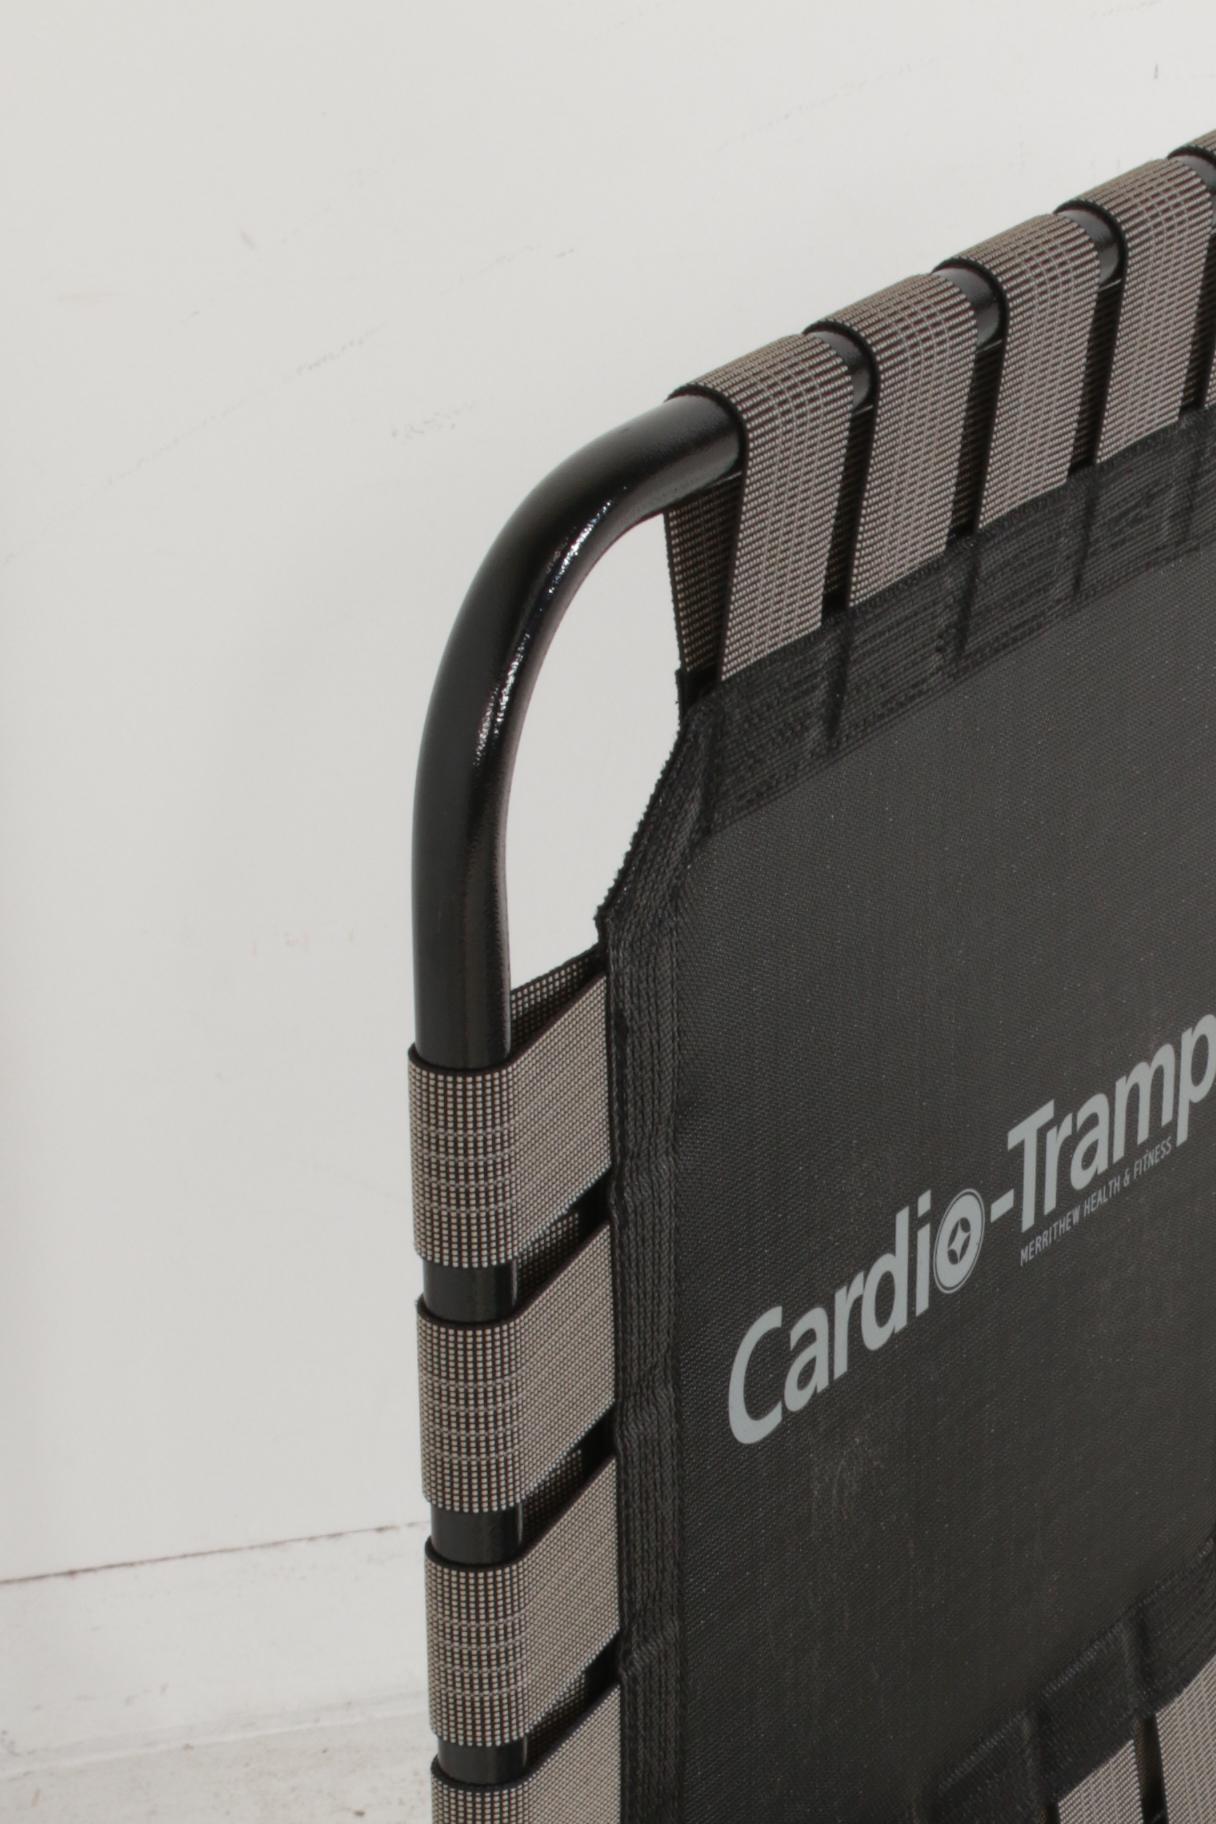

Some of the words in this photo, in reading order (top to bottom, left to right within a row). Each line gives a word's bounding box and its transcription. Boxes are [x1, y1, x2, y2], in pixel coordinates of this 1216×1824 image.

[1020, 1204, 1081, 1266] MERRITHEW
[1084, 1175, 1121, 1217] HEALTH
[1123, 1168, 1131, 1187] &
[1133, 1136, 1172, 1179] FITNESS
